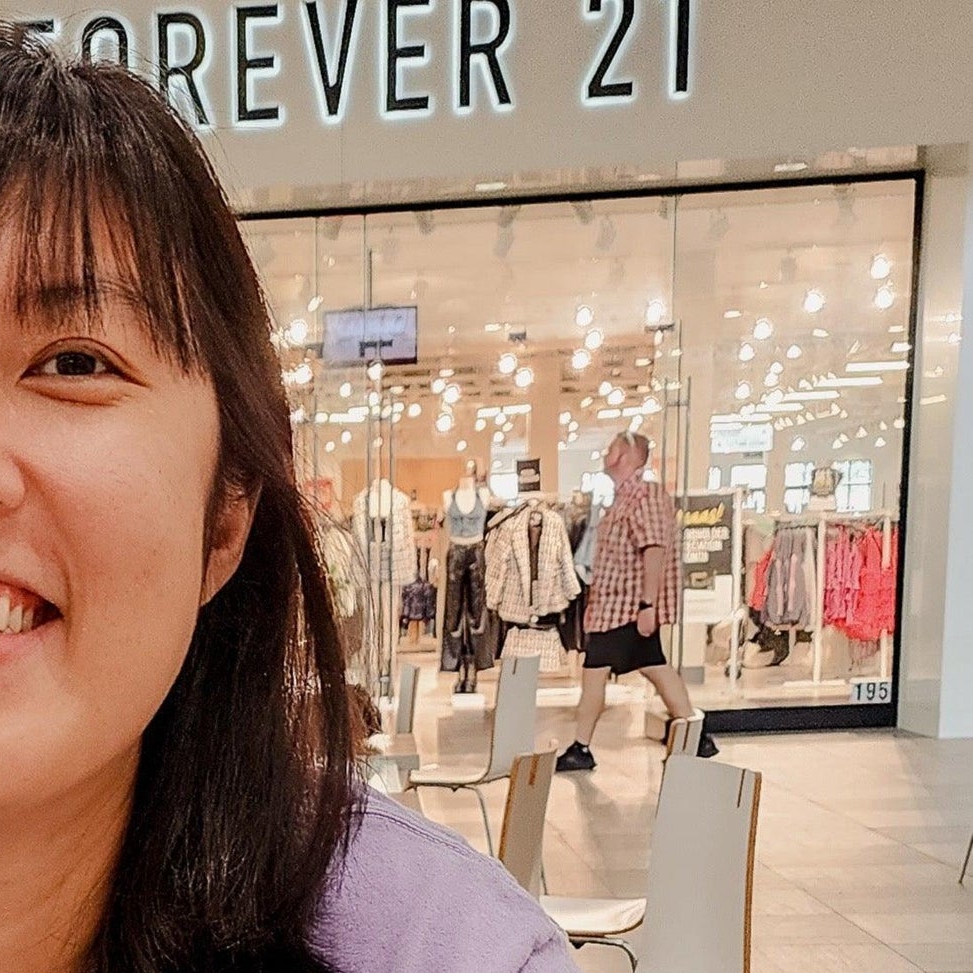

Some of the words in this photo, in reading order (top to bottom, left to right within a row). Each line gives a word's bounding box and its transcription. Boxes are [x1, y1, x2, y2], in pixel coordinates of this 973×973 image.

[11, 0, 513, 126] REVER
[588, 0, 690, 98] 21
[854, 681, 888, 701] 195
